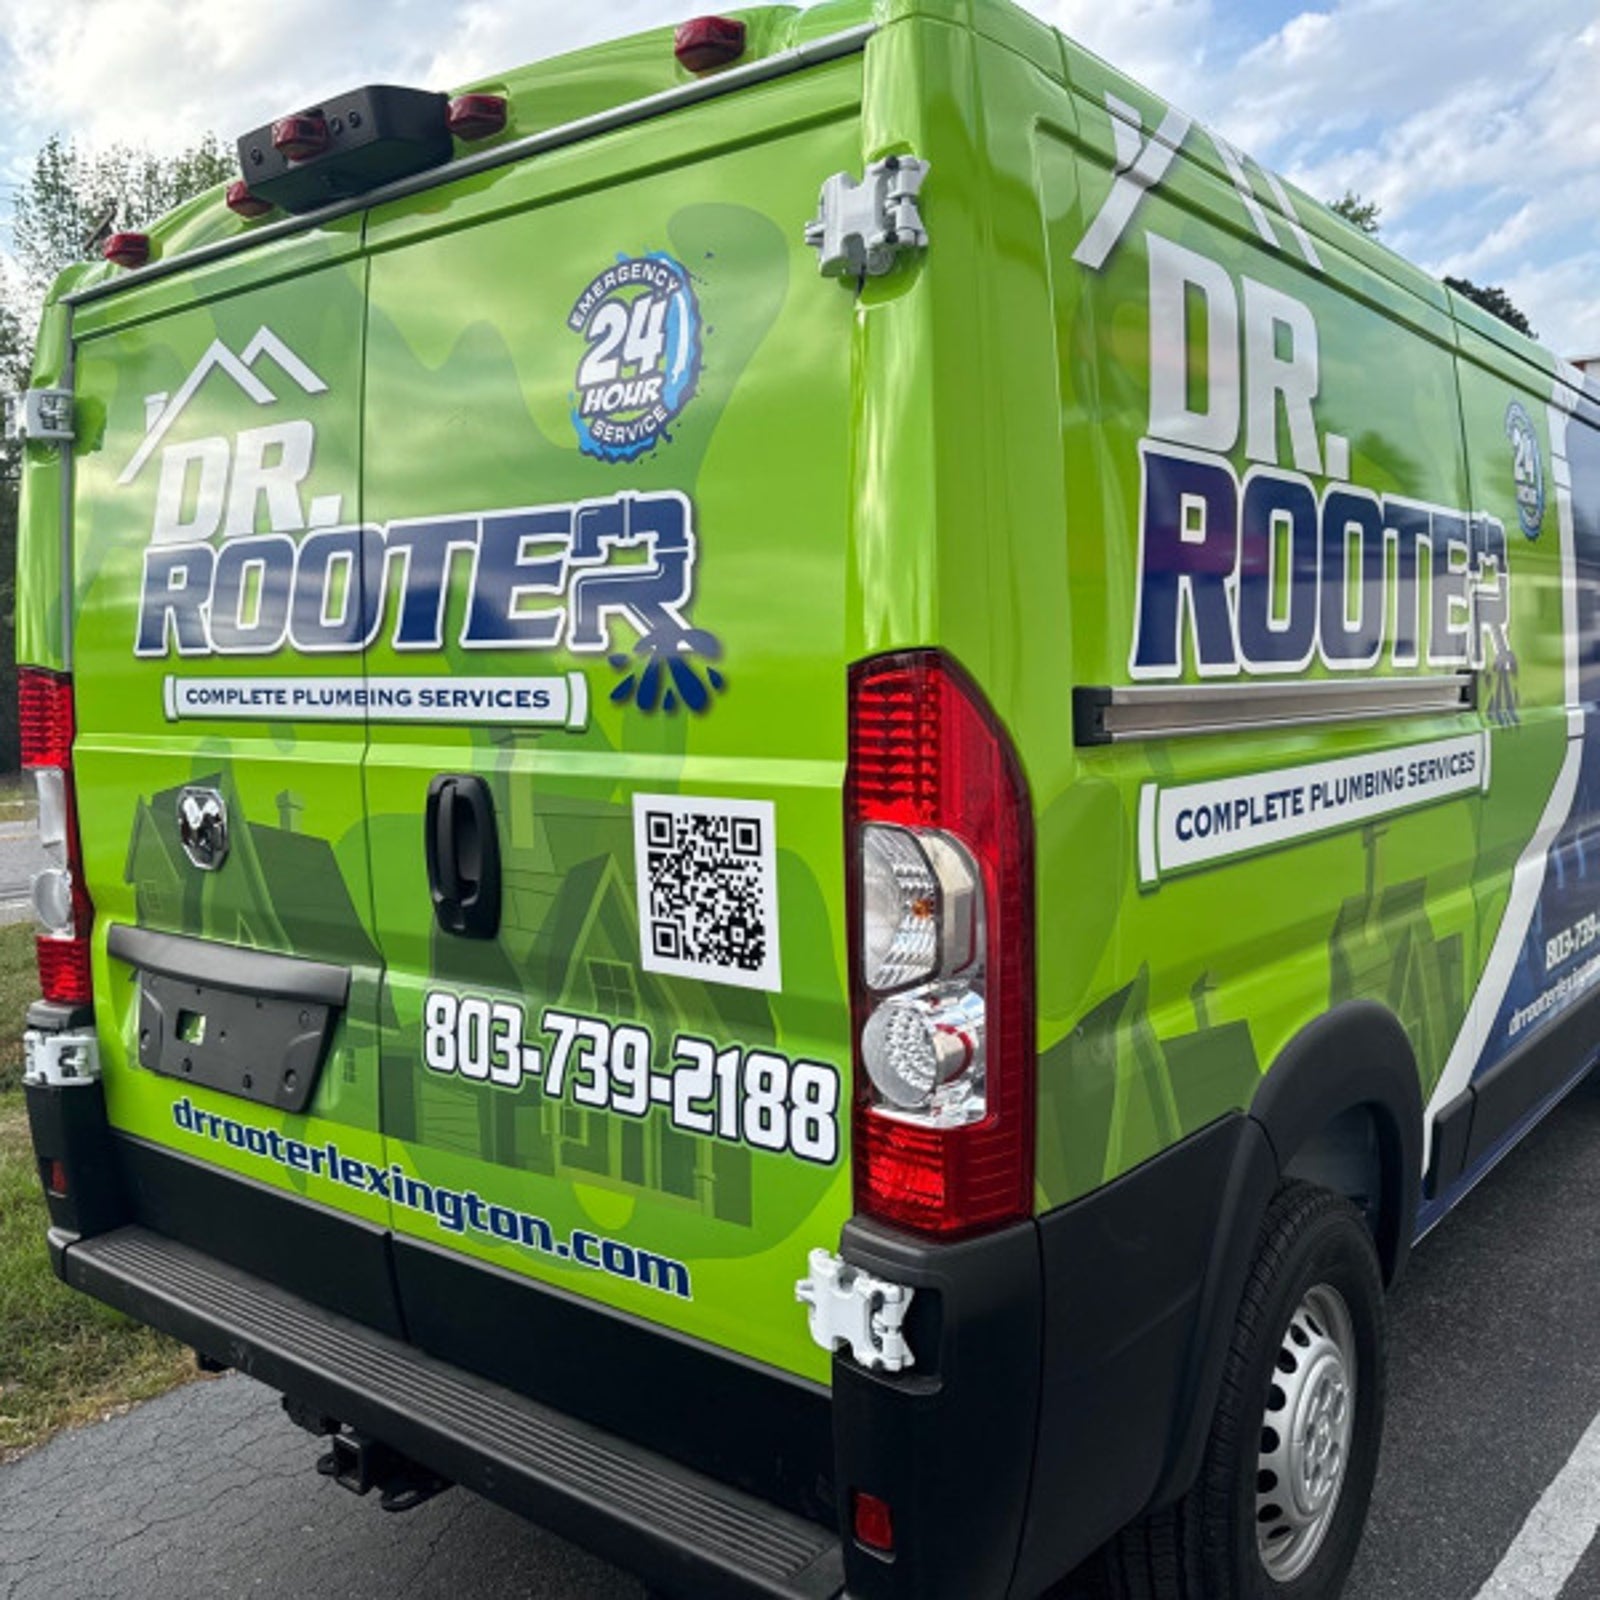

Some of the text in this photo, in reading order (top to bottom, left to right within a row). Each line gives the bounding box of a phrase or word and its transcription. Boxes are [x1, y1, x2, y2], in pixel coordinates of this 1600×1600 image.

[570, 263, 678, 328] EMERGENCY
[578, 294, 668, 386] 24
[583, 377, 662, 414] HOUR
[1146, 231, 1350, 481] DR.
[591, 405, 667, 442] SERVICE
[152, 419, 343, 544] DR.
[134, 490, 694, 657] ROOTER
[1128, 436, 1510, 680] ROOTER
[186, 689, 550, 708] COMPLETE PLUMBING SERVICES
[1175, 751, 1475, 841] COMPLETE PLUMBING SERVICES
[422, 991, 841, 1164] 803-739-2188
[172, 1097, 692, 1300] drrooterlexington.com
